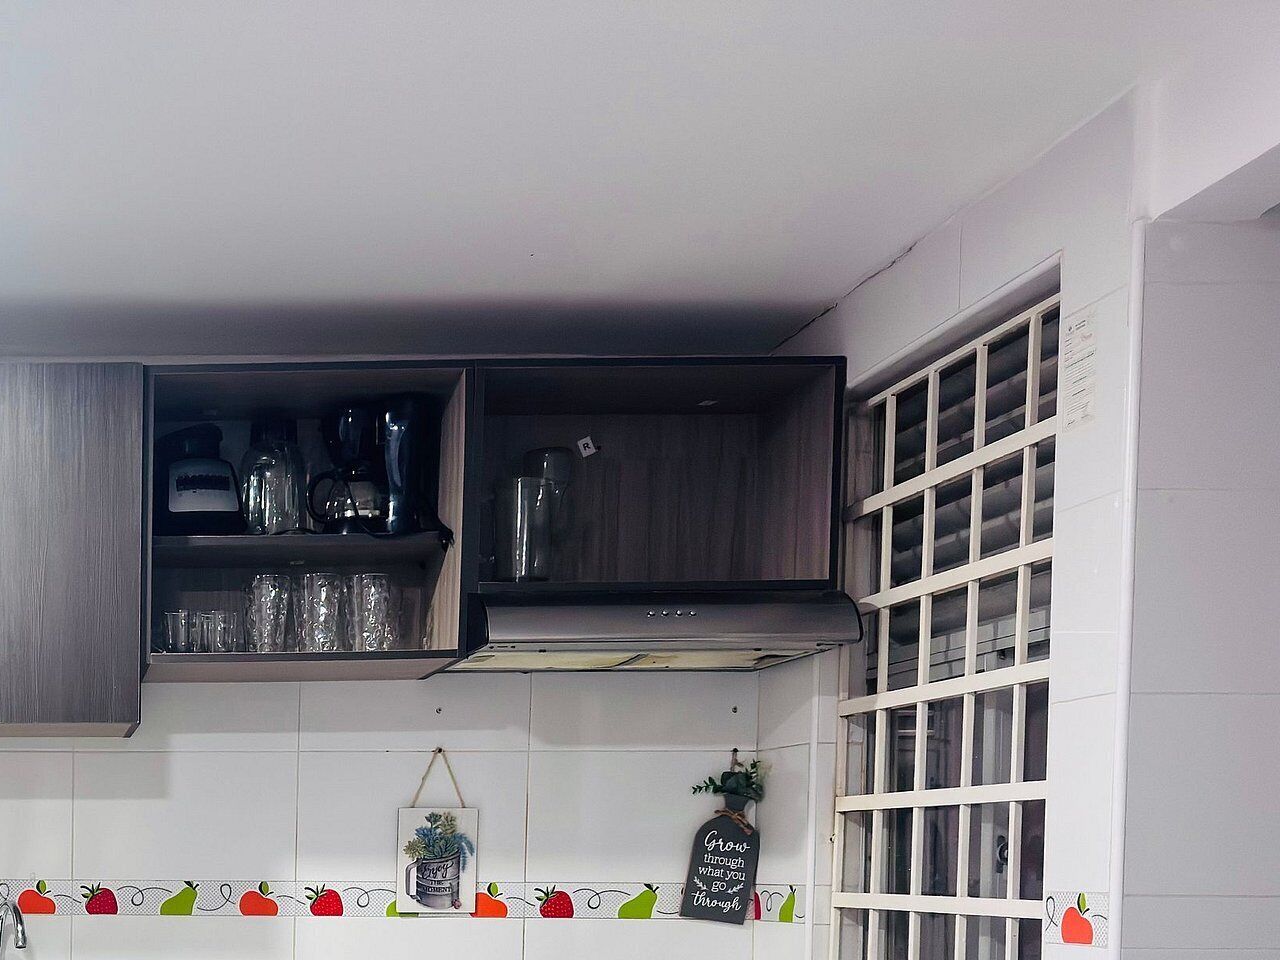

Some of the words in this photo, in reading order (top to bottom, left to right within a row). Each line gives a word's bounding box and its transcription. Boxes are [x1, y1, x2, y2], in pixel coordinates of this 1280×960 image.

[704, 830, 751, 853] Grow
[421, 860, 454, 879] Enjoy
[704, 853, 745, 869] through
[698, 866, 724, 878] what
[725, 870, 746, 881] you
[711, 881, 727, 893] go
[691, 890, 741, 913] through
